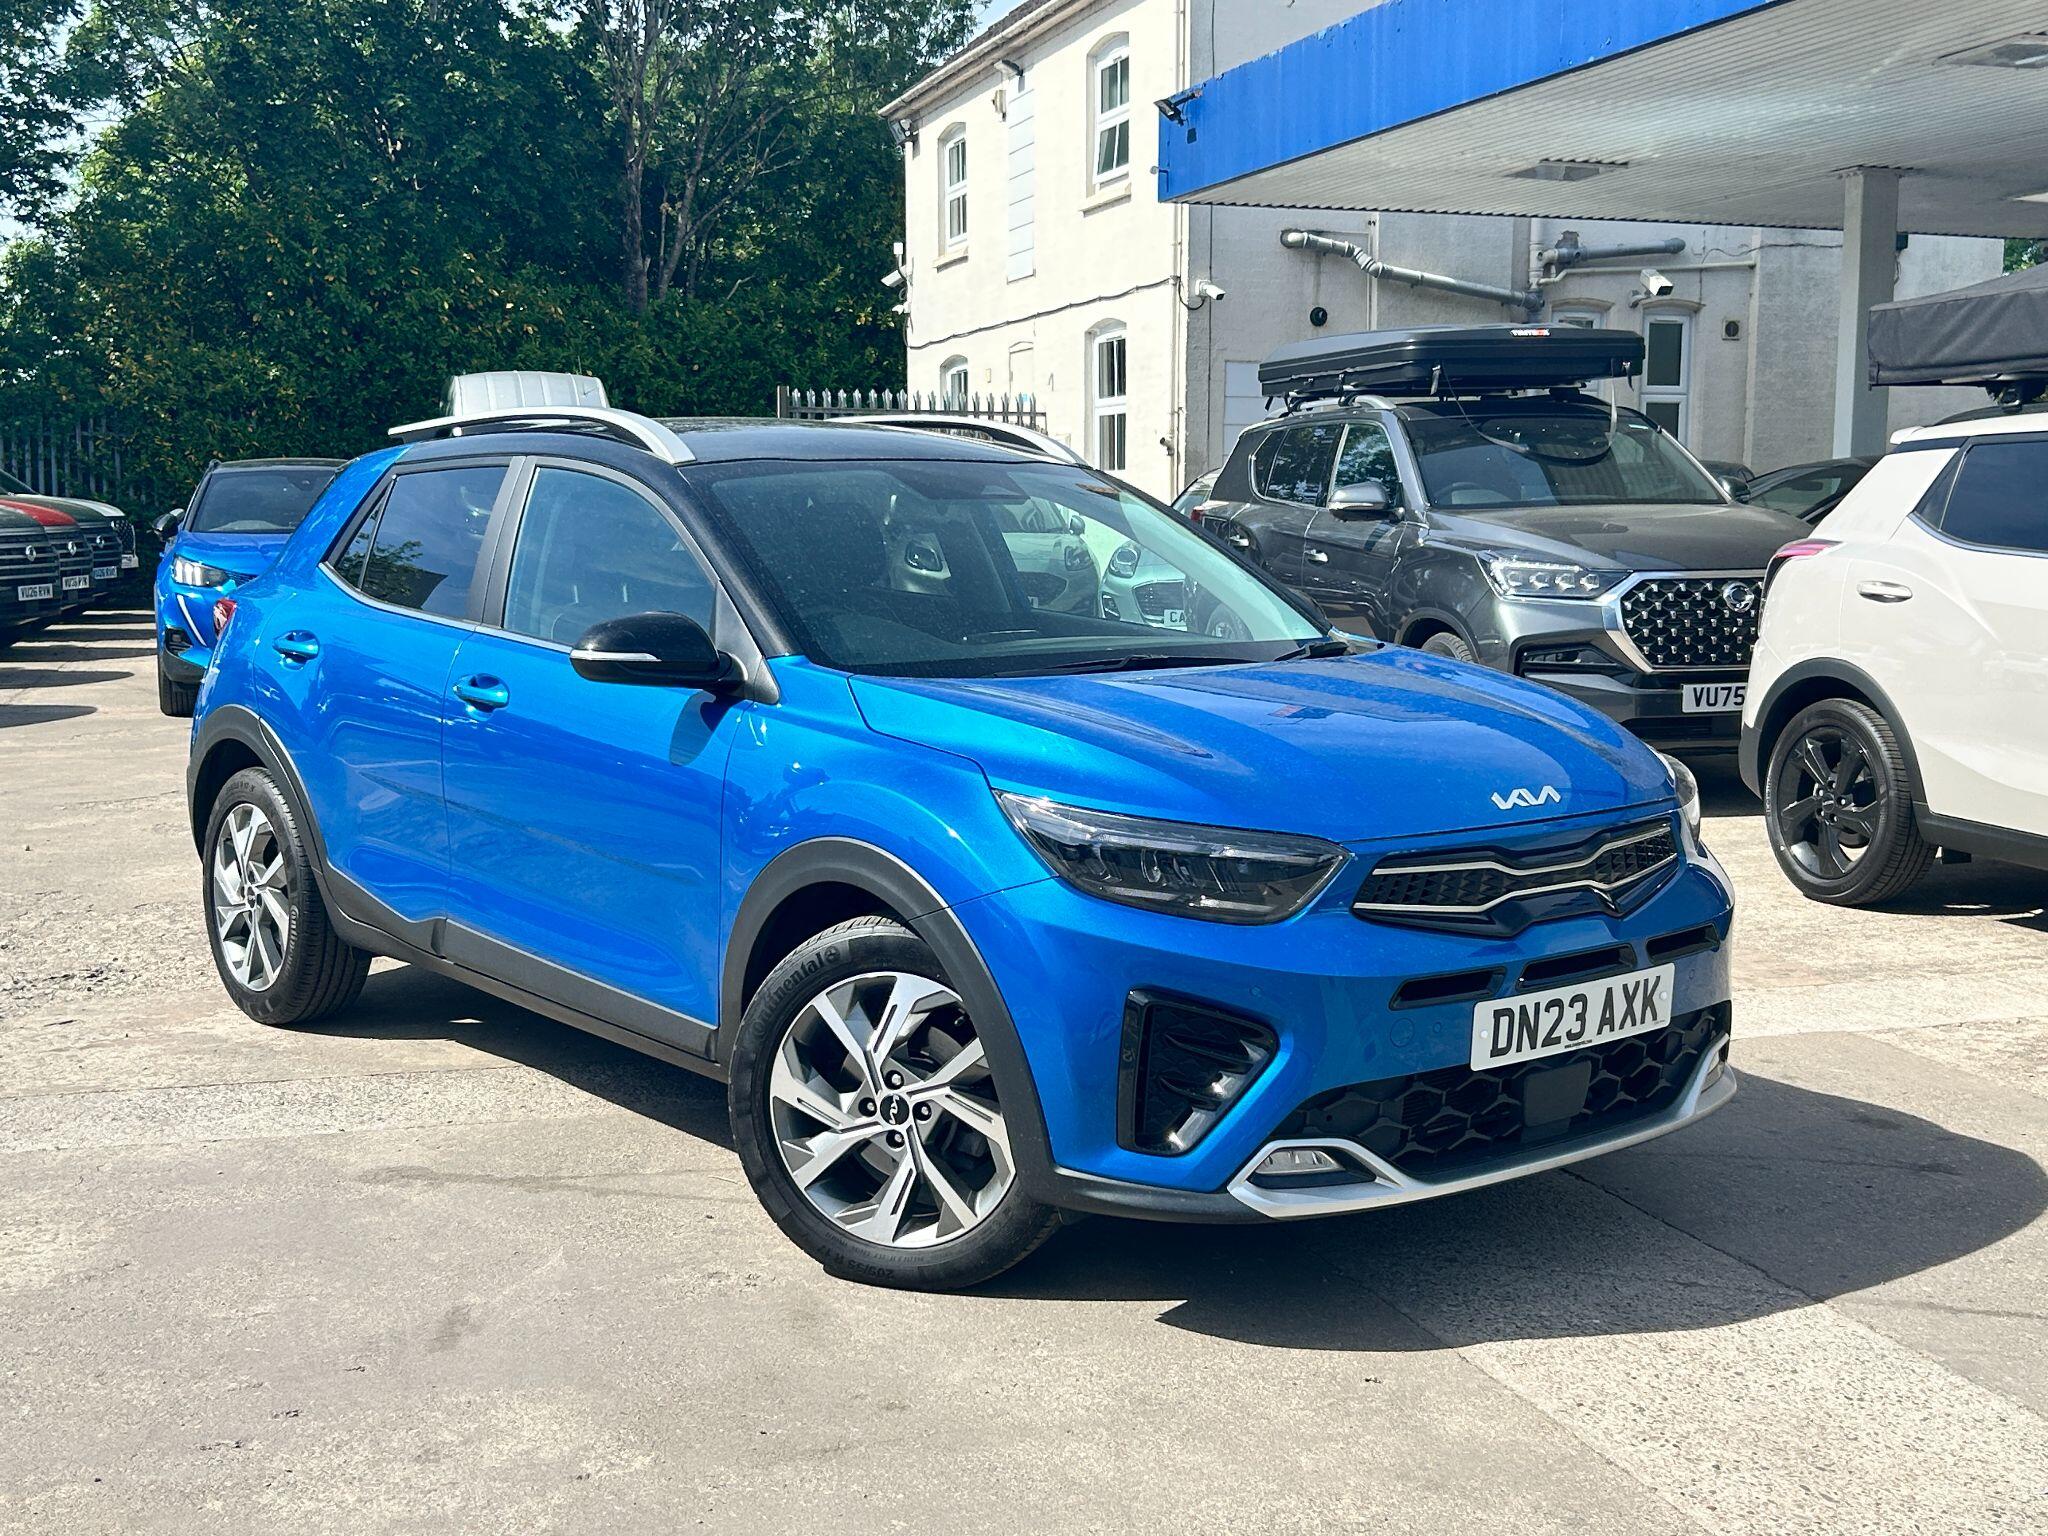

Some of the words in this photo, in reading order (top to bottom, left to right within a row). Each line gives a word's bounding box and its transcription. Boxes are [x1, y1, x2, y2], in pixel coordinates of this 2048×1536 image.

[1693, 686, 1746, 707] VU75
[1491, 785, 1561, 810] KIA
[1490, 993, 1588, 1058] DN23
[1597, 975, 1661, 1036] AXK
